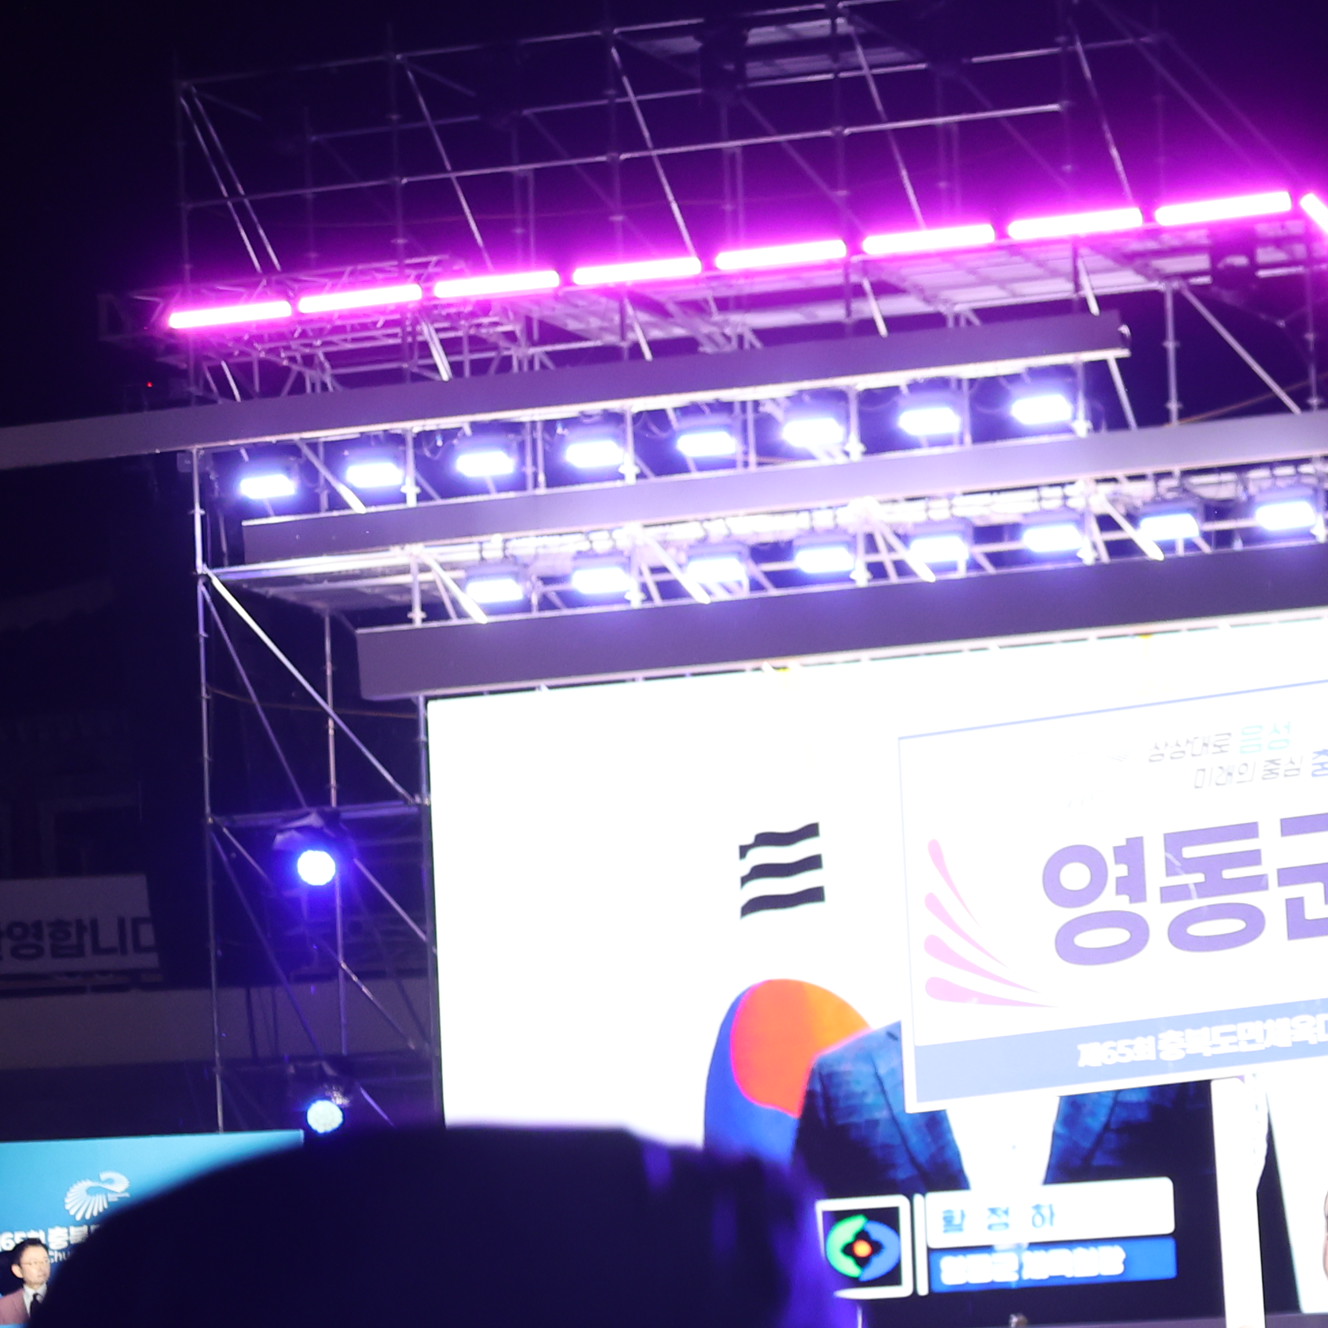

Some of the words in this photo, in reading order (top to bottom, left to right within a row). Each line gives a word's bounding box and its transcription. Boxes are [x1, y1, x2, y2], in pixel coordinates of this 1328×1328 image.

[1148, 731, 1232, 763] 상상대로
[1239, 722, 1292, 755] 음성
[1193, 761, 1257, 789] 미래의
[1261, 756, 1303, 780] 중심
